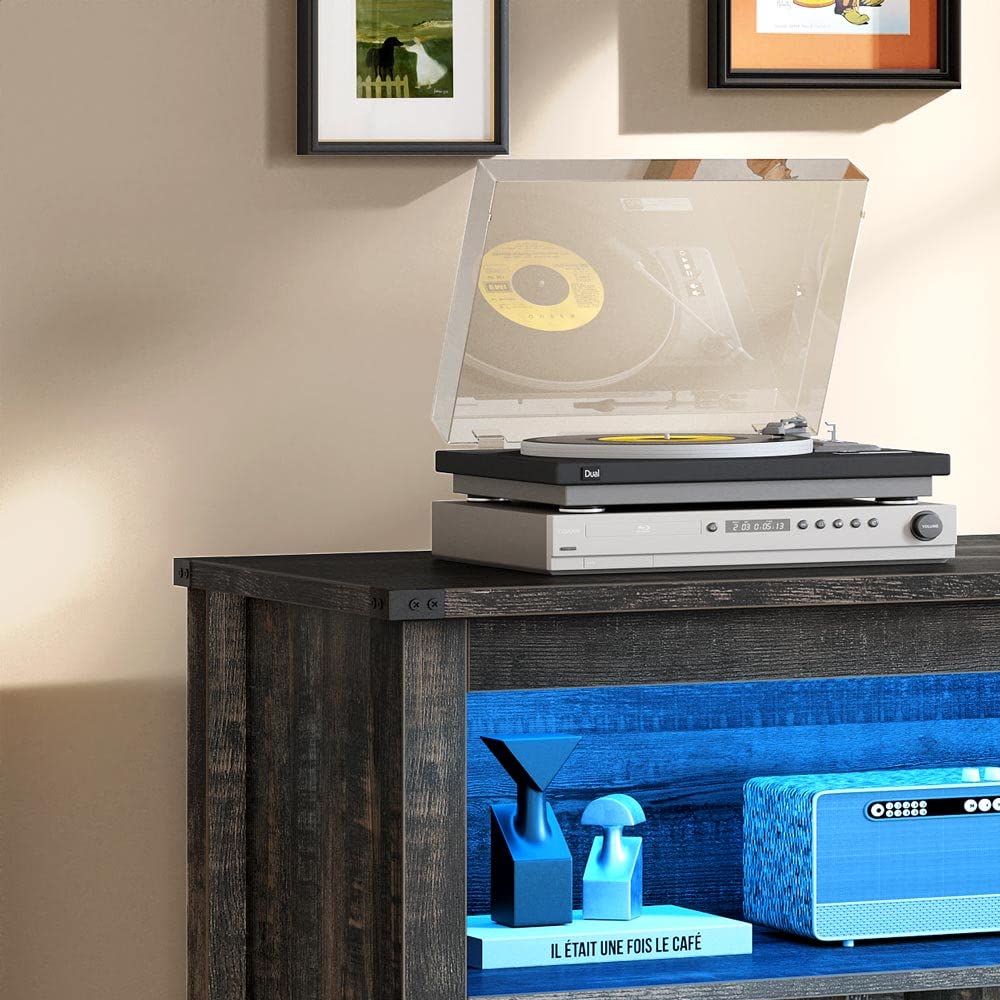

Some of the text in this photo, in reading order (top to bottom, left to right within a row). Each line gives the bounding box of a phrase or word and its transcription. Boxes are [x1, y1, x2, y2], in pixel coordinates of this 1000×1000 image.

[584, 468, 600, 478] Dual
[551, 931, 702, 959] IL ÉTAIT UNE FOIS LE CAFÉ
